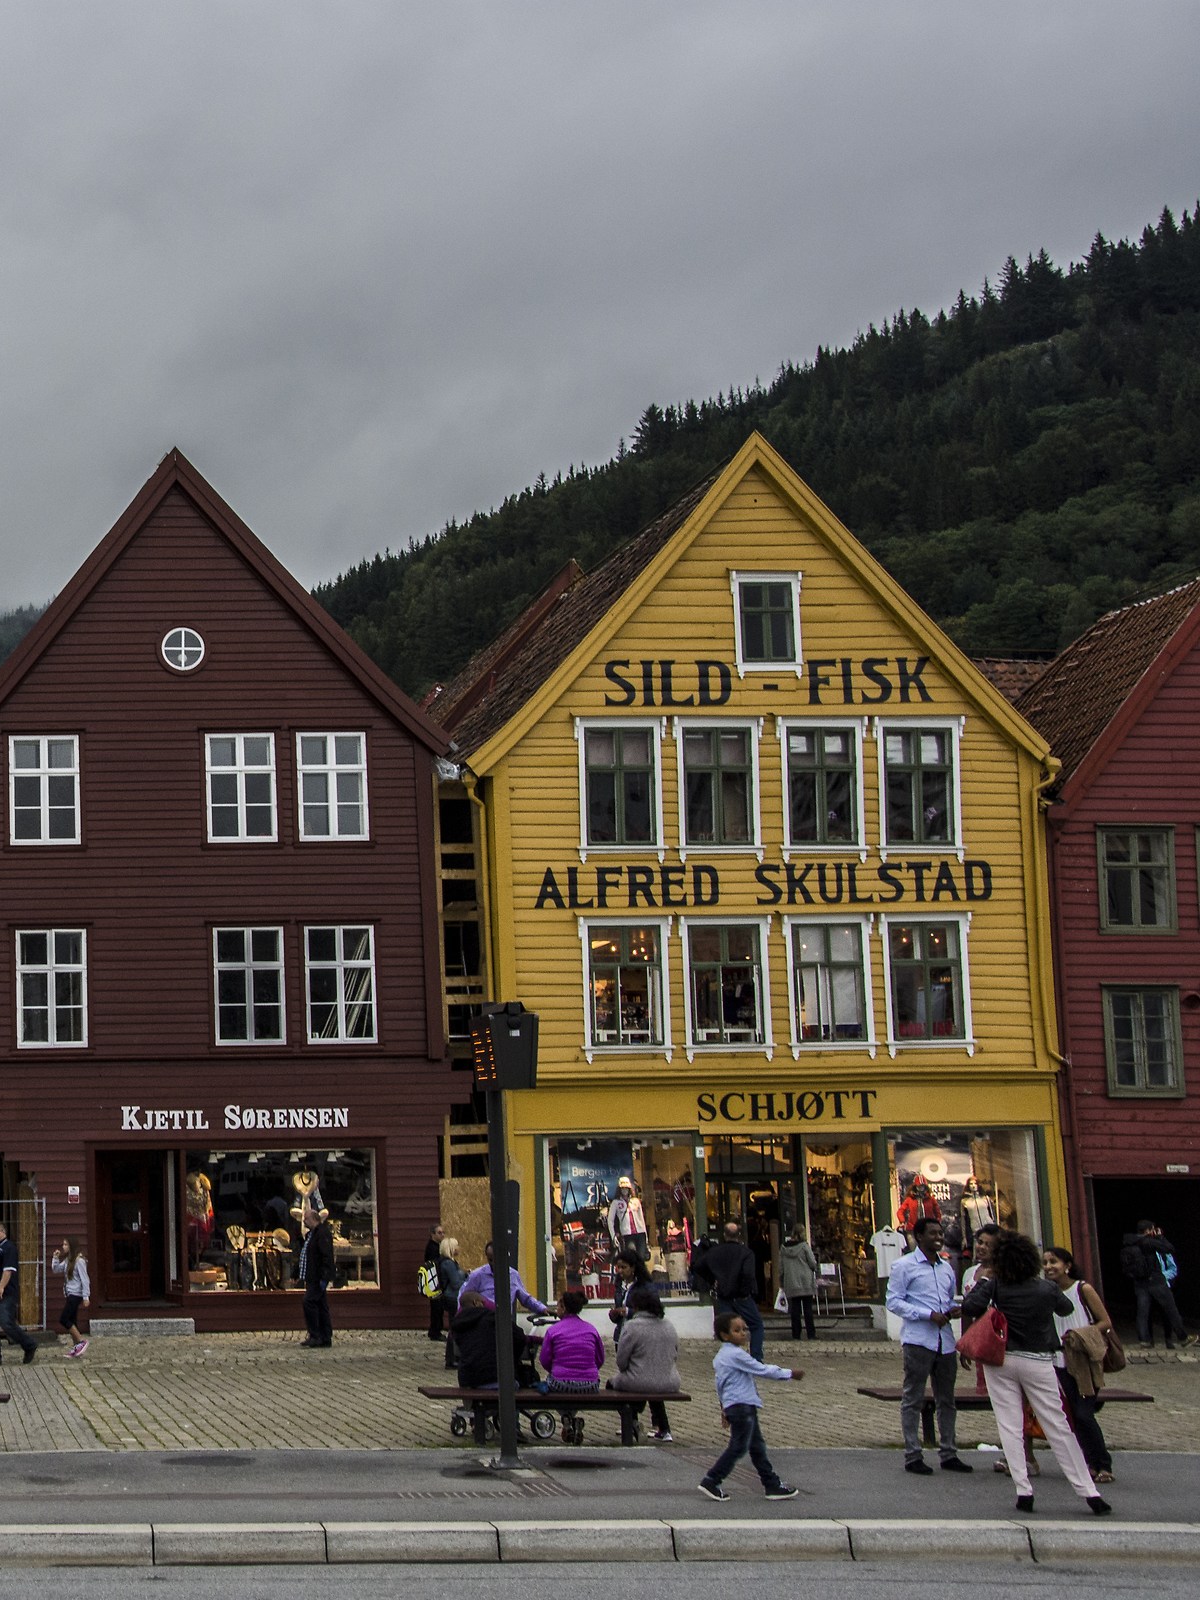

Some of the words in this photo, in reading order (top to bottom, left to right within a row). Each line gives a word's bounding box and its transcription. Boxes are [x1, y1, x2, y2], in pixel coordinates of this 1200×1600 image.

[604, 659, 733, 707] SILD
[807, 656, 934, 705] FISK
[535, 864, 720, 909] ALFRED
[755, 860, 993, 905] SKULSTAD
[697, 1090, 877, 1122] SCHJØTT
[572, 1166, 607, 1179] Bergen
